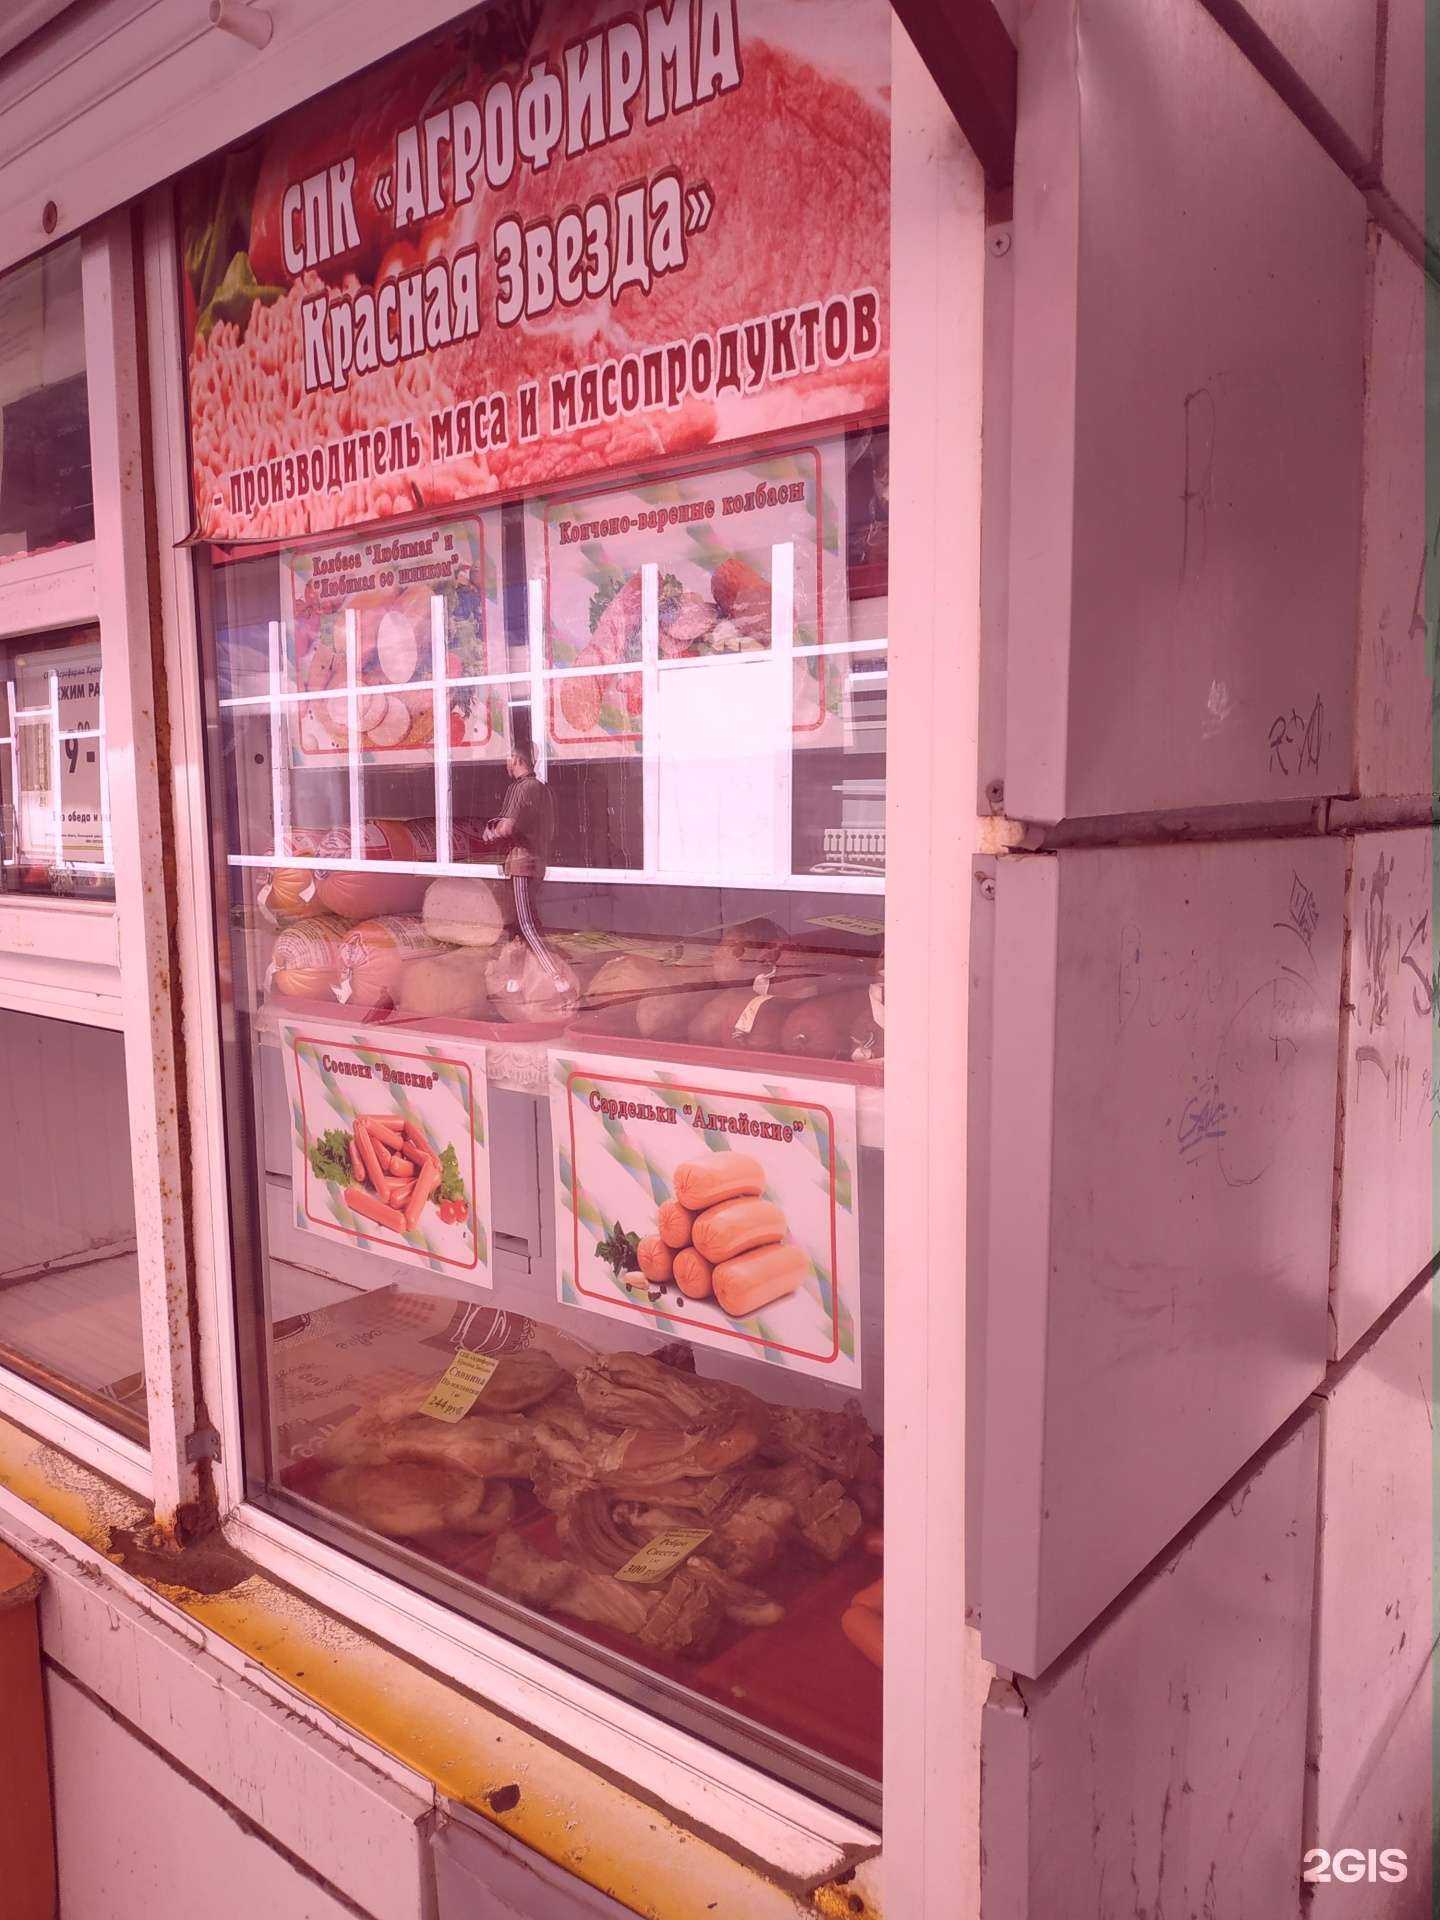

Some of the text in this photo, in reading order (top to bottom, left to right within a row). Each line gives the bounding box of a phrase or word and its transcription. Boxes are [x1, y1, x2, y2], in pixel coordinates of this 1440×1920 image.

[282, 0, 740, 276] СПК «АГРОФИРМА
[302, 176, 713, 390] Красная Звезда»
[230, 421, 420, 515] производитель
[431, 396, 507, 461] мяса
[519, 386, 537, 439] и
[551, 292, 878, 431] мясопродуктов
[559, 480, 806, 545] Копчено-вареные колбасы
[379, 570, 395, 588] со
[67, 810, 91, 824] обеда
[322, 1053, 373, 1080] Сосиски
[589, 1090, 677, 1125] Сардельки
